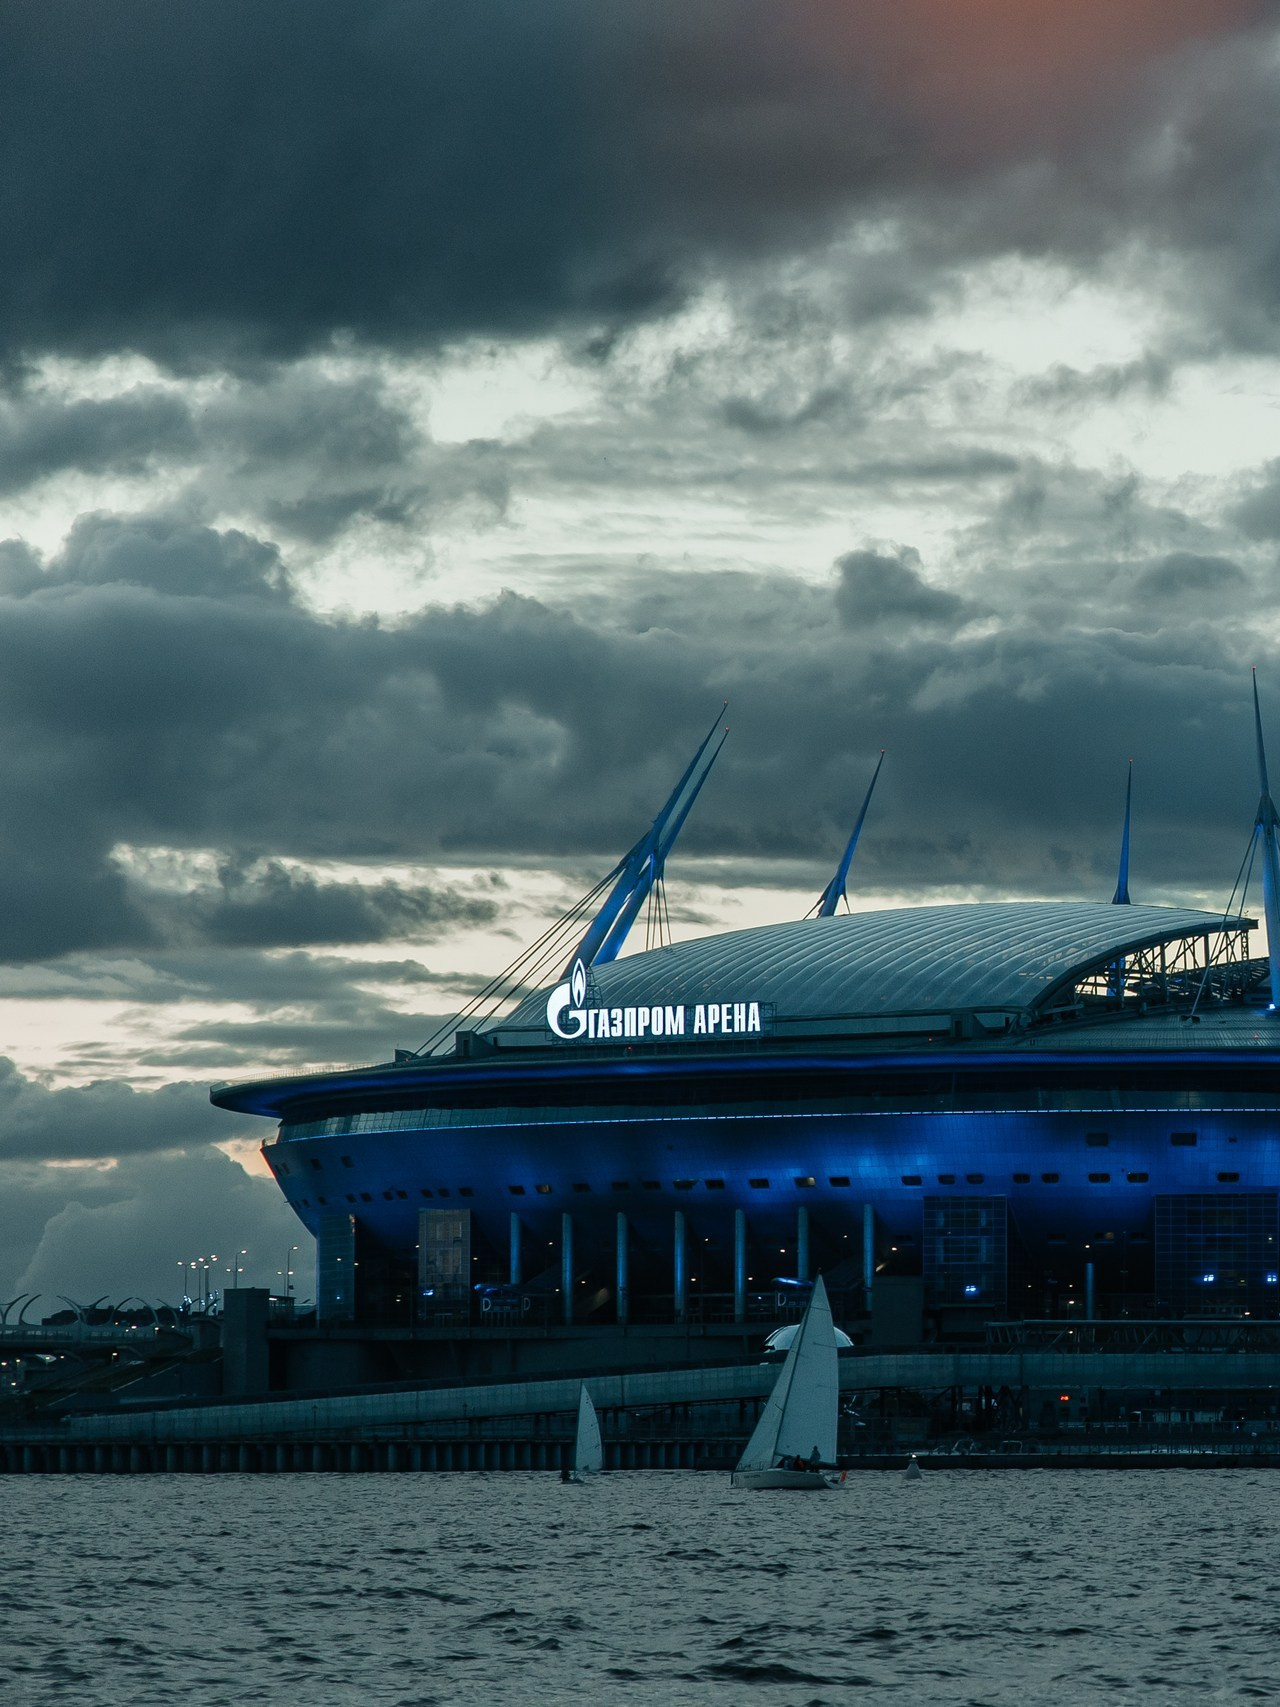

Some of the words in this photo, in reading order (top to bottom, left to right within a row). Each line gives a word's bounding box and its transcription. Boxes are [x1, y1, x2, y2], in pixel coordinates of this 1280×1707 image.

[588, 1005, 685, 1039] ГАЗПРОМ
[693, 1002, 761, 1034] АРЕНА
[482, 1297, 492, 1312] D
